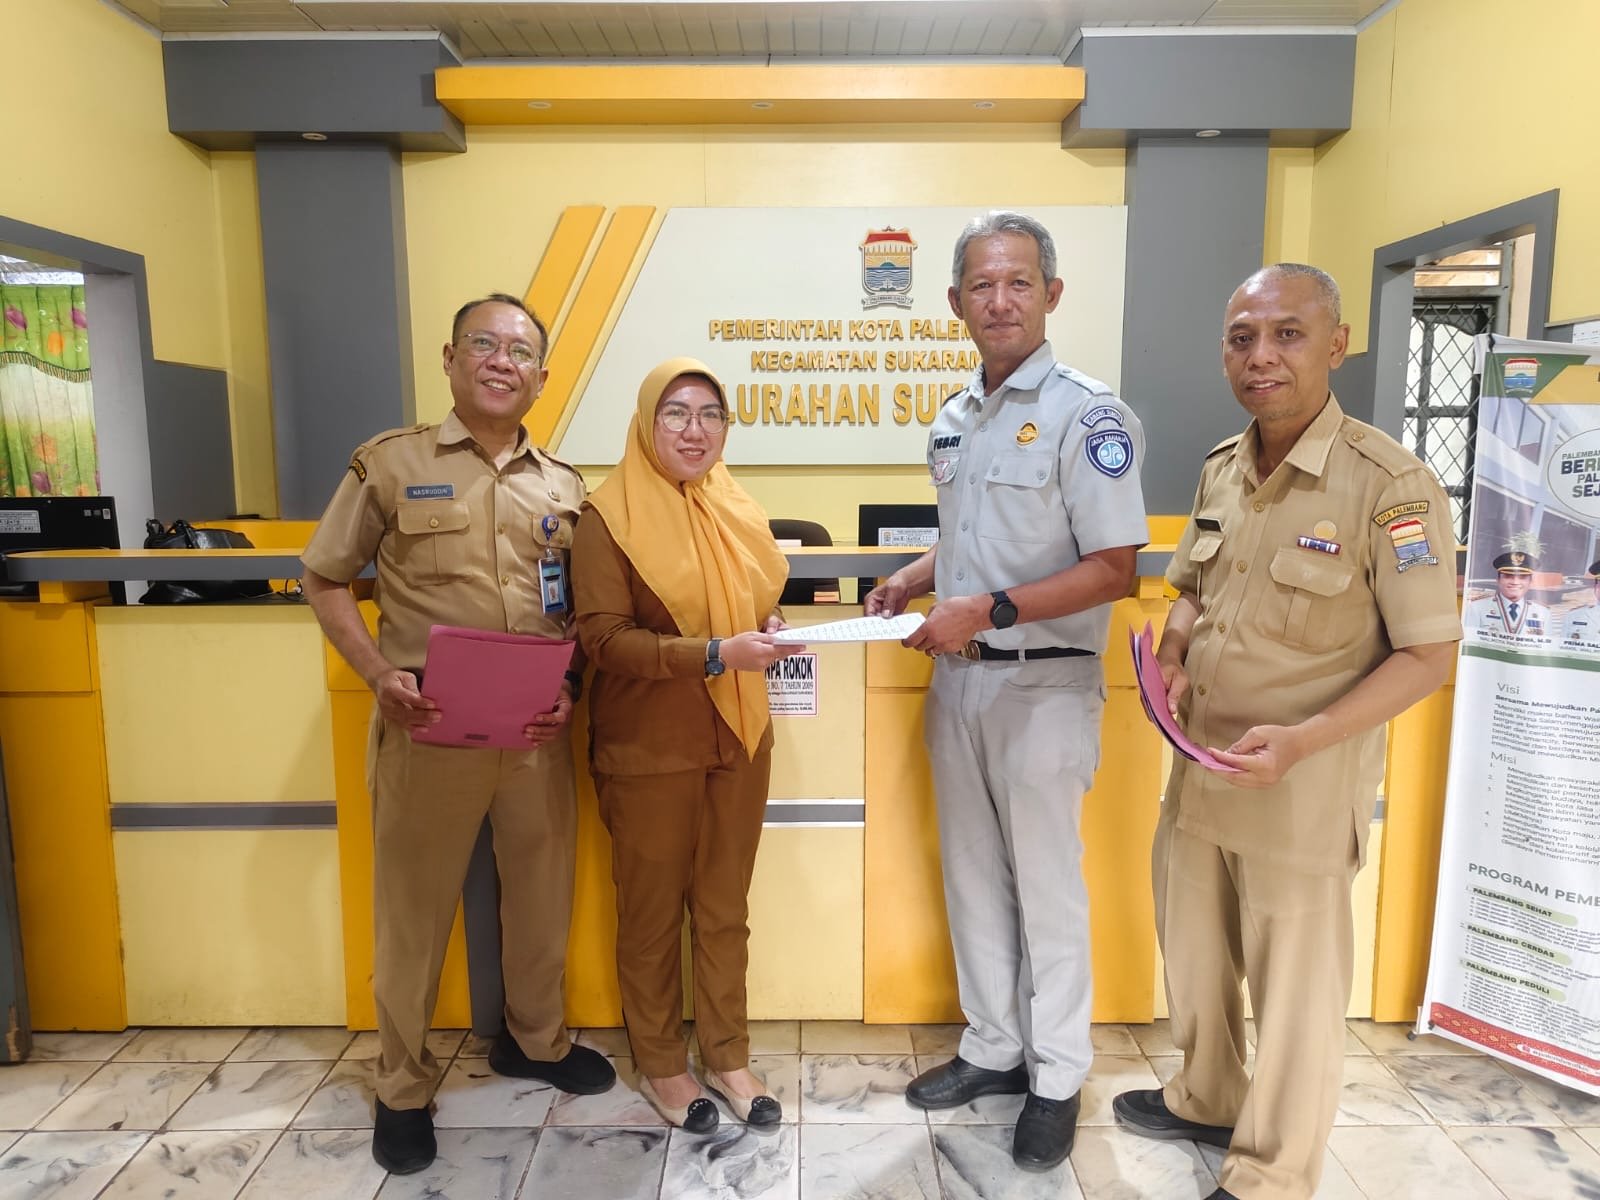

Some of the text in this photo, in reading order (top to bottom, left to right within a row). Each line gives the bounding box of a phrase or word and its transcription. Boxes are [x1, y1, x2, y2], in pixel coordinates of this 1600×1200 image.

[709, 319, 842, 341] PEMERINTAH
[849, 319, 903, 340] KOTA
[751, 351, 877, 370] KECAMATAN
[1561, 450, 1600, 460] PALEMBA
[1561, 457, 1600, 475] BER
[1376, 503, 1427, 523] KOTA PALEMBANG
[783, 656, 814, 680] ROKOK
[1497, 682, 1520, 695] Visi
[1495, 694, 1529, 706] Bersama
[1531, 700, 1588, 712] Mewujudkan
[1491, 751, 1517, 765] Misi
[1468, 862, 1549, 897] PROGRAM
[1473, 887, 1524, 907] PALEMBANG
[1525, 903, 1553, 918] SEHAT
[1467, 925, 1519, 945] PALEMBANG
[1521, 941, 1555, 958] CERDAS
[1466, 961, 1550, 995] PALEMBANG PEDULI
